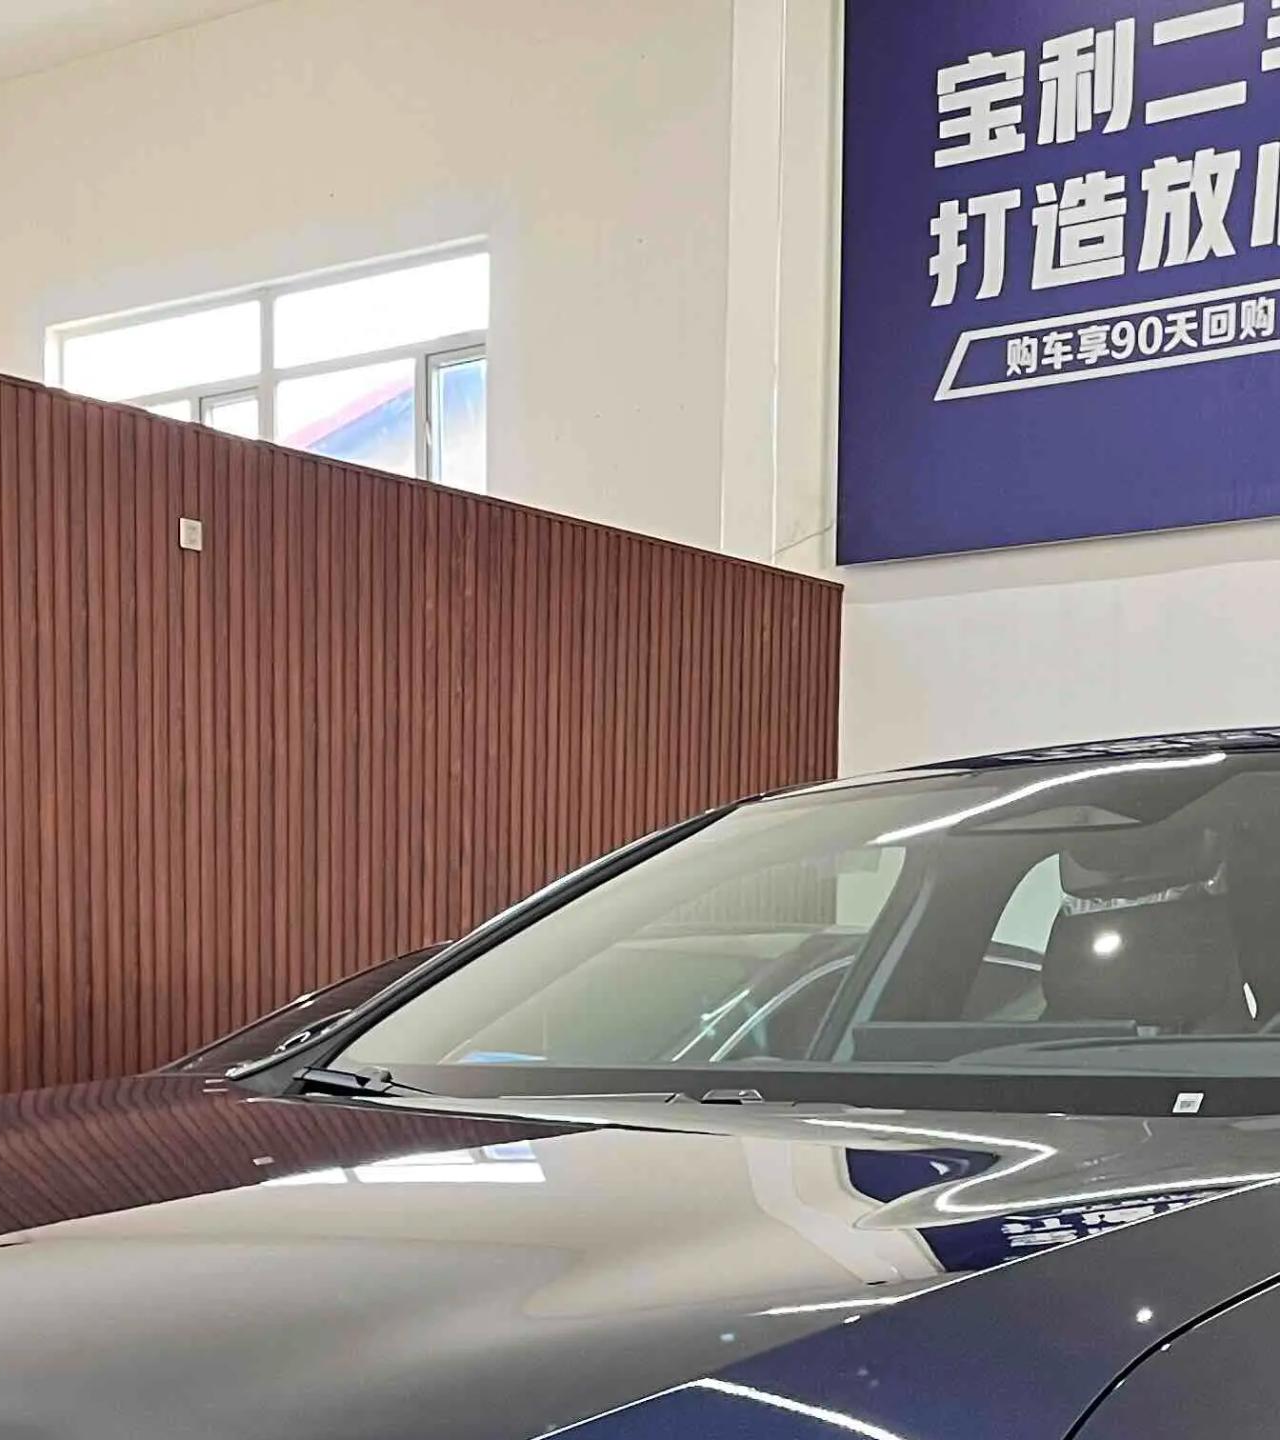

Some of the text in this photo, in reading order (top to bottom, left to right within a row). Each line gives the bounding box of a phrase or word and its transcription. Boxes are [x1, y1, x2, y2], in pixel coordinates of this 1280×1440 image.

[1005, 296, 1276, 376] 购车享90天回购
